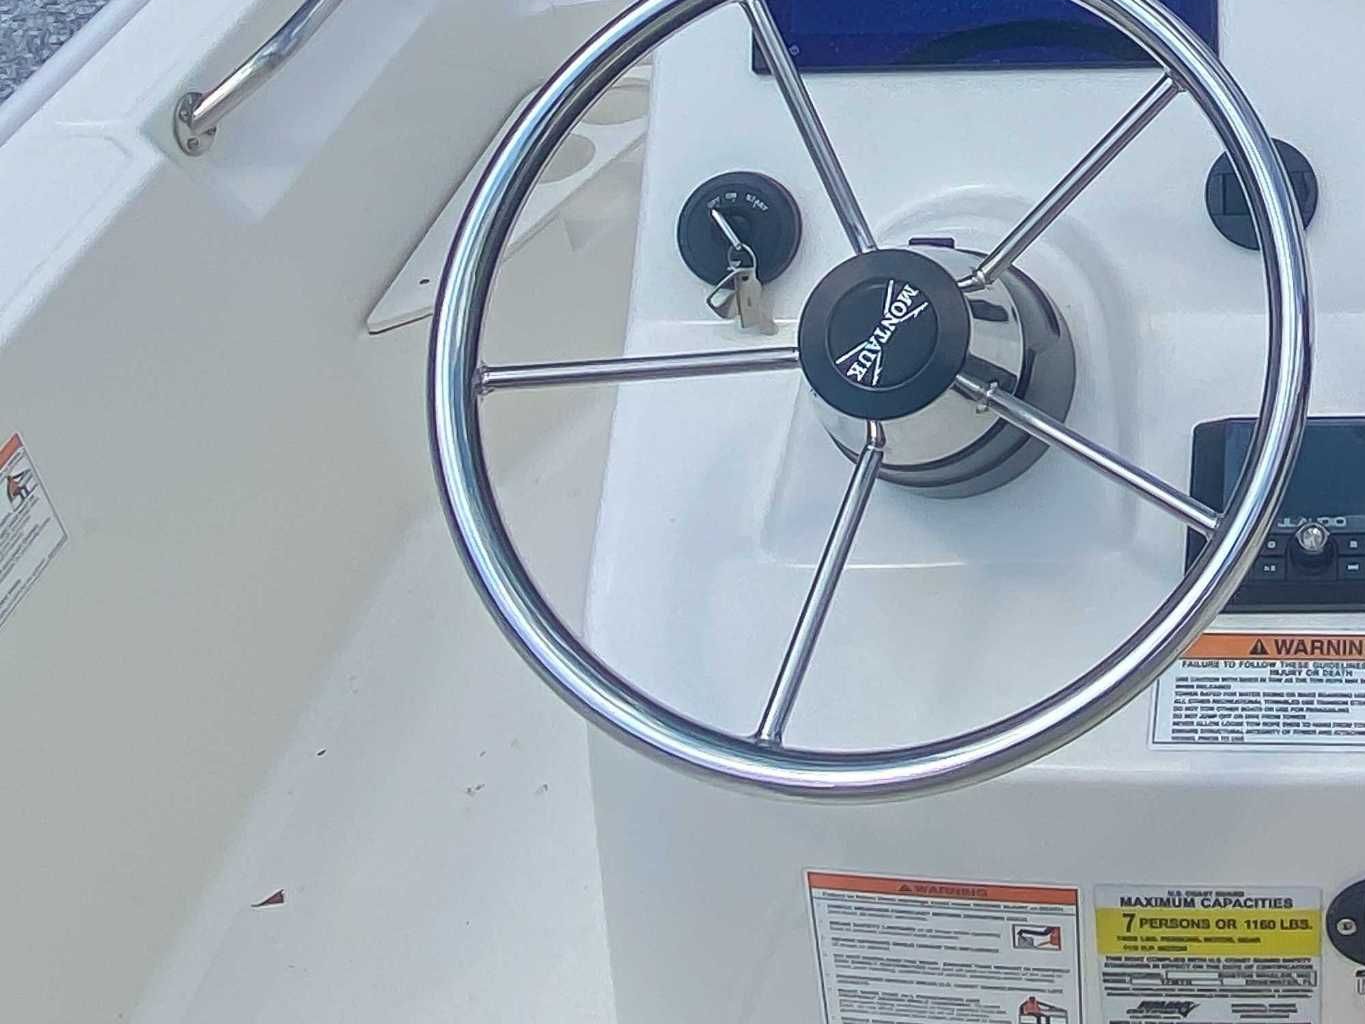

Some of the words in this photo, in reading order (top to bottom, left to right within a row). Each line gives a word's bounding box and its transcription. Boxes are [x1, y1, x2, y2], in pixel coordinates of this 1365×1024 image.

[847, 283, 920, 382] MONTAUK
[914, 885, 988, 897] WARNING
[1120, 897, 1195, 908] MAXIMUM
[1201, 898, 1293, 908] CAPACITIES
[1122, 913, 1136, 932] 7
[1139, 918, 1210, 929] PERSONS
[1215, 919, 1237, 929] OR
[1244, 919, 1276, 930] 1160
[1280, 919, 1313, 930] LBS.
